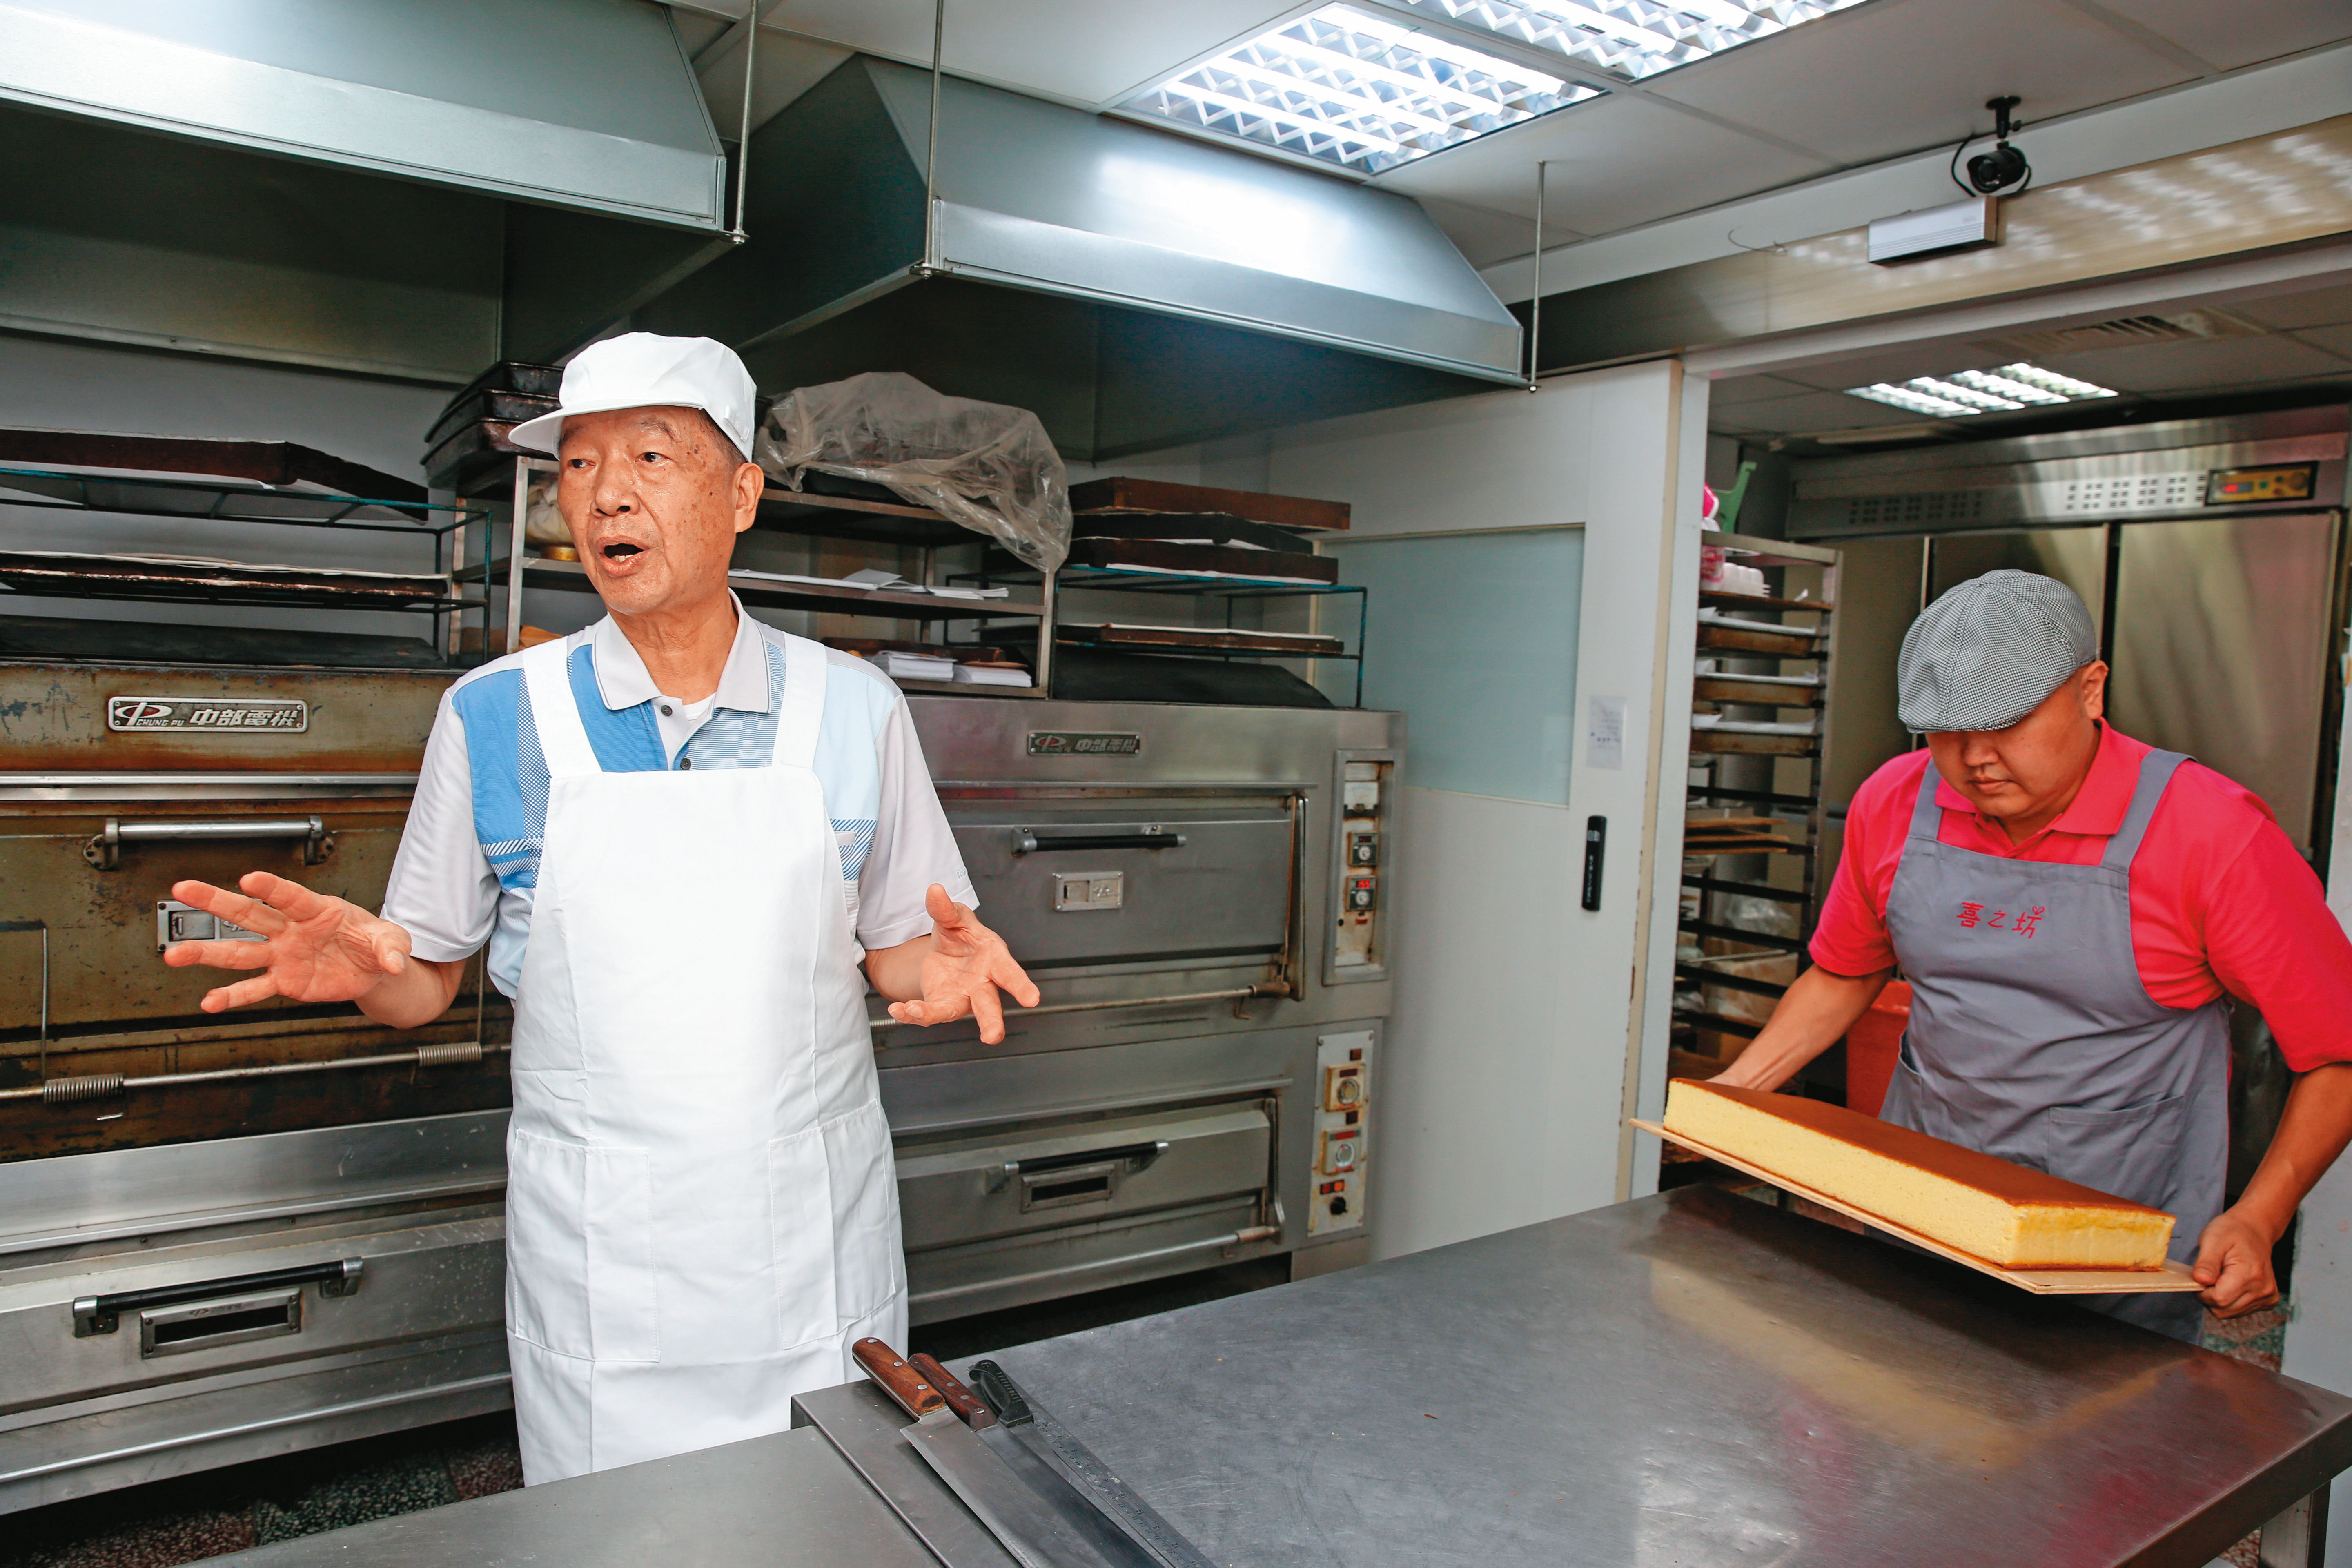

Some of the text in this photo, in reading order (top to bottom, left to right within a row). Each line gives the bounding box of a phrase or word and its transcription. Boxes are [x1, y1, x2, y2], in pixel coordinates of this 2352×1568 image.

[189, 708, 299, 726] 中部電機
[1956, 902, 2046, 939] 喜之坊
